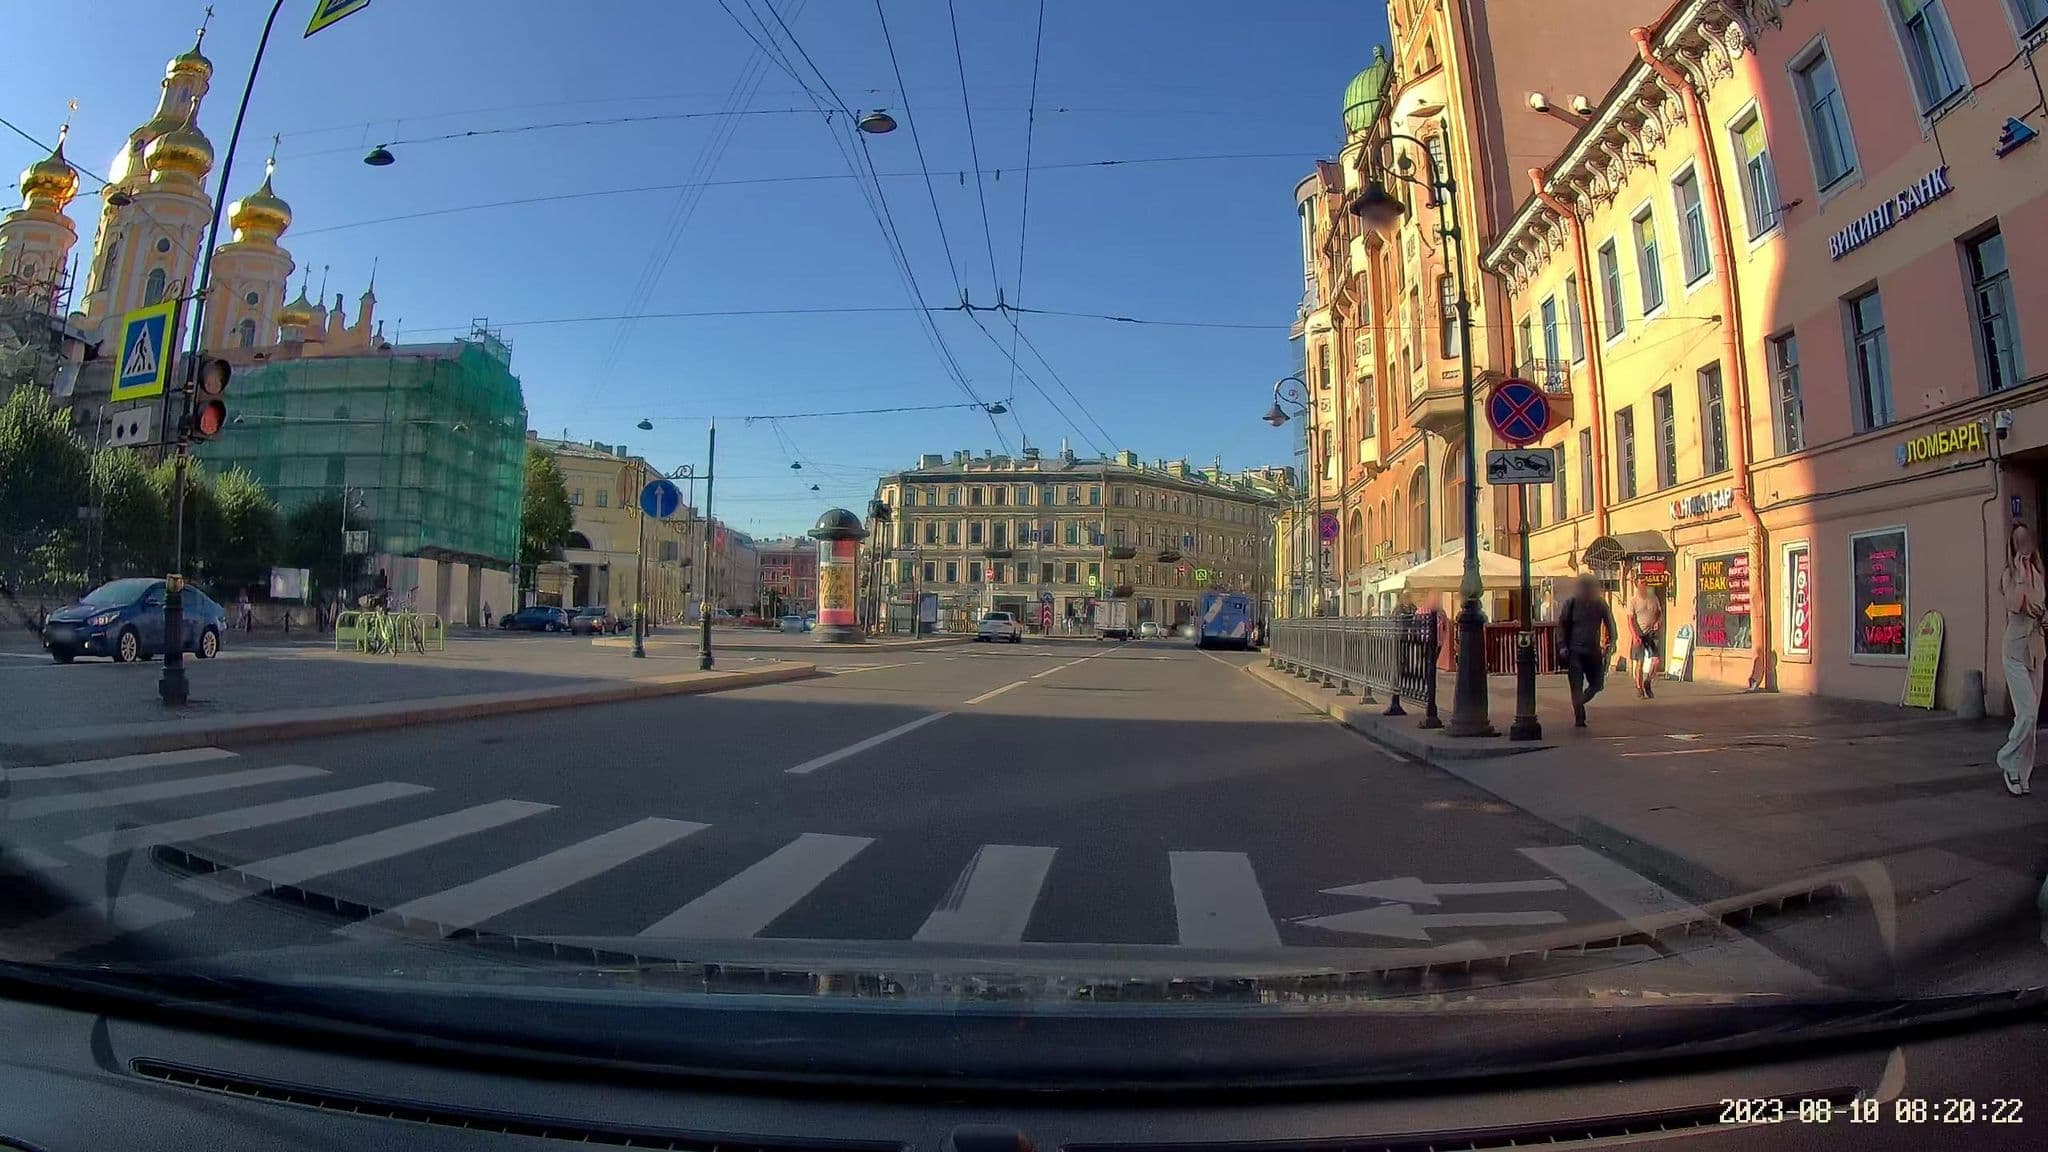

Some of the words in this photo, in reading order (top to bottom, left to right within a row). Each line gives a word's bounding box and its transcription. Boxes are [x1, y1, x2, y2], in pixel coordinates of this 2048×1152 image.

[1828, 199, 1893, 260] ВИКИНГ
[1895, 165, 1952, 218] БАНК
[1907, 422, 1981, 463] ЛОМБАРД
[1711, 488, 1733, 510] БАР
[1702, 561, 1723, 575] КИНГ
[1700, 576, 1726, 591] ТАБАК
